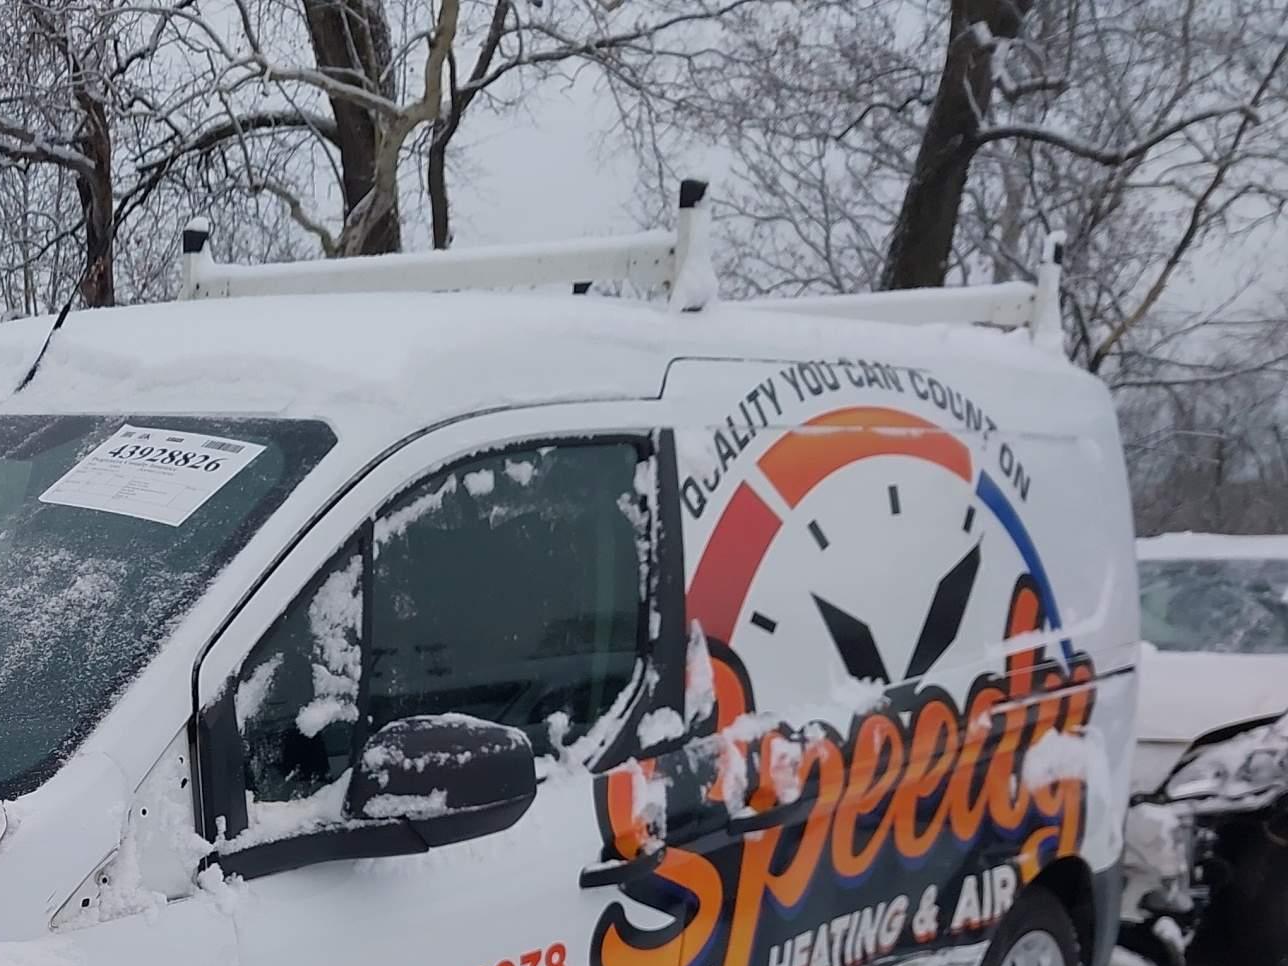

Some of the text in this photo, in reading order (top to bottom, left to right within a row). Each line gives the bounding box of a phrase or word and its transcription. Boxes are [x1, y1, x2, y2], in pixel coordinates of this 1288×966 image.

[108, 444, 230, 473] 43928826
[780, 361, 841, 402] YOU
[846, 361, 905, 393] CAN
[908, 369, 998, 442] COUNT
[999, 443, 1032, 503] ON
[912, 884, 939, 944] &
[950, 865, 1020, 934] AIR
